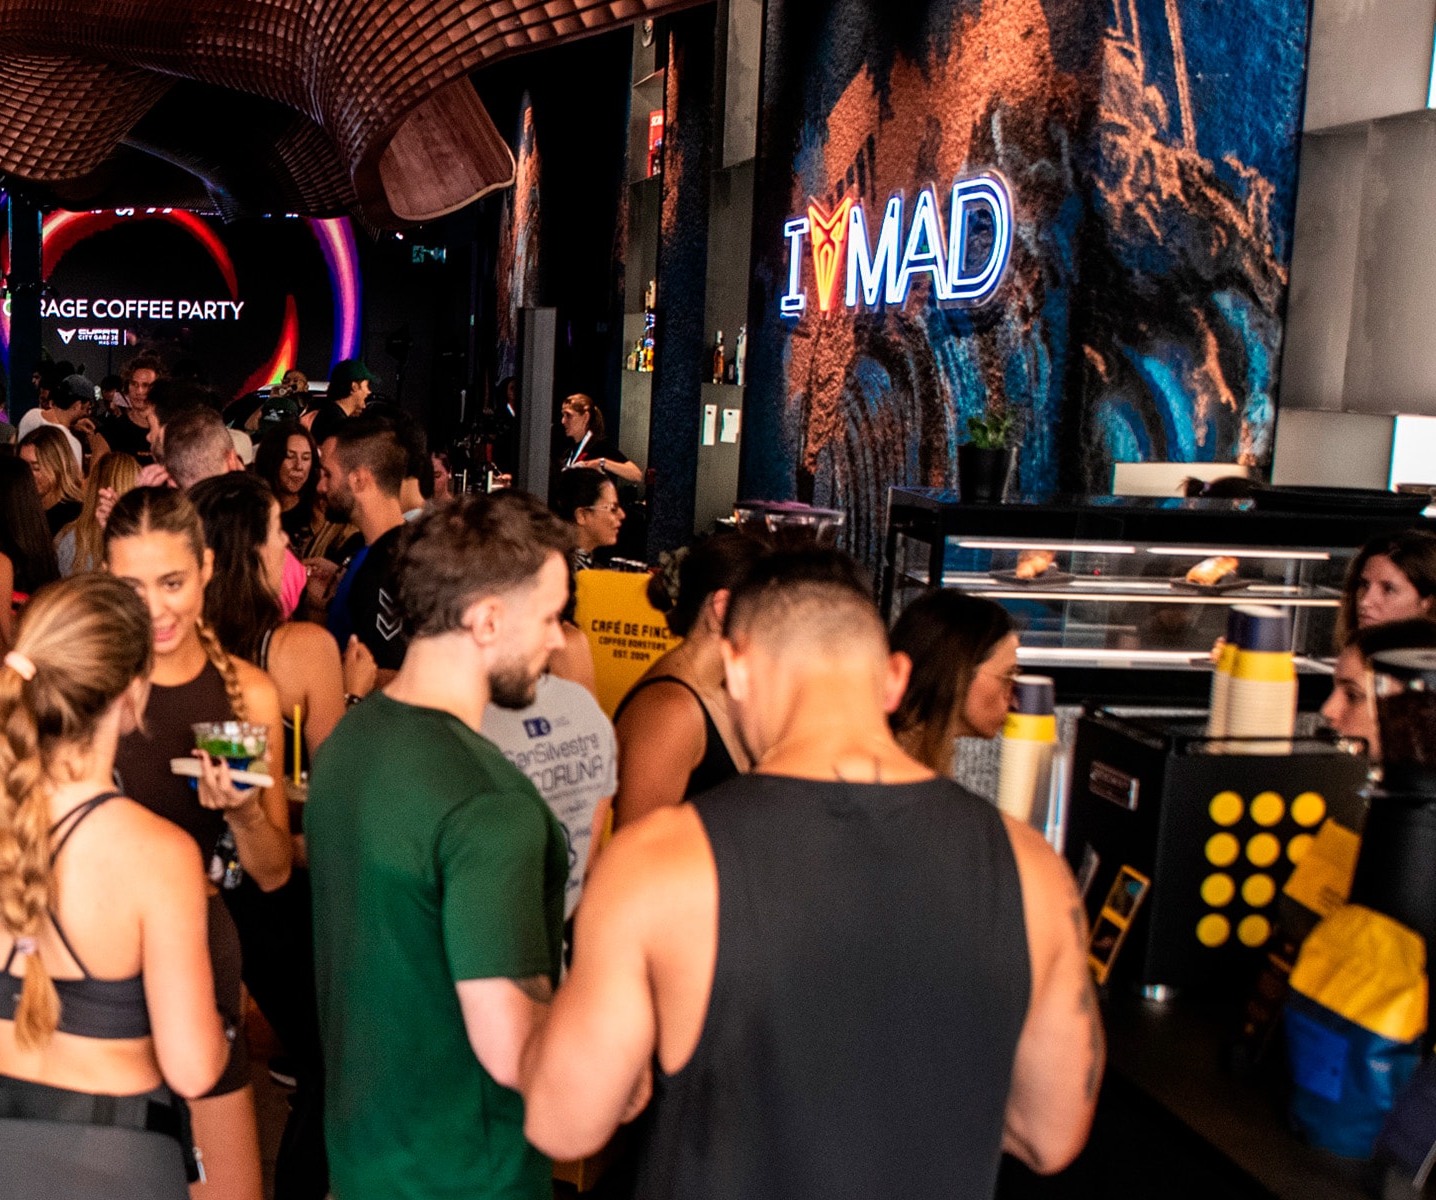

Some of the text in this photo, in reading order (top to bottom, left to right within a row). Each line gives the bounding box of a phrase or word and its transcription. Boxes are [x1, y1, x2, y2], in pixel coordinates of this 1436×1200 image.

[780, 176, 1012, 312] I MAD
[92, 299, 174, 319] COFFEE
[178, 300, 244, 321] PARTY
[591, 619, 677, 640] CAFÉ DE FINC
